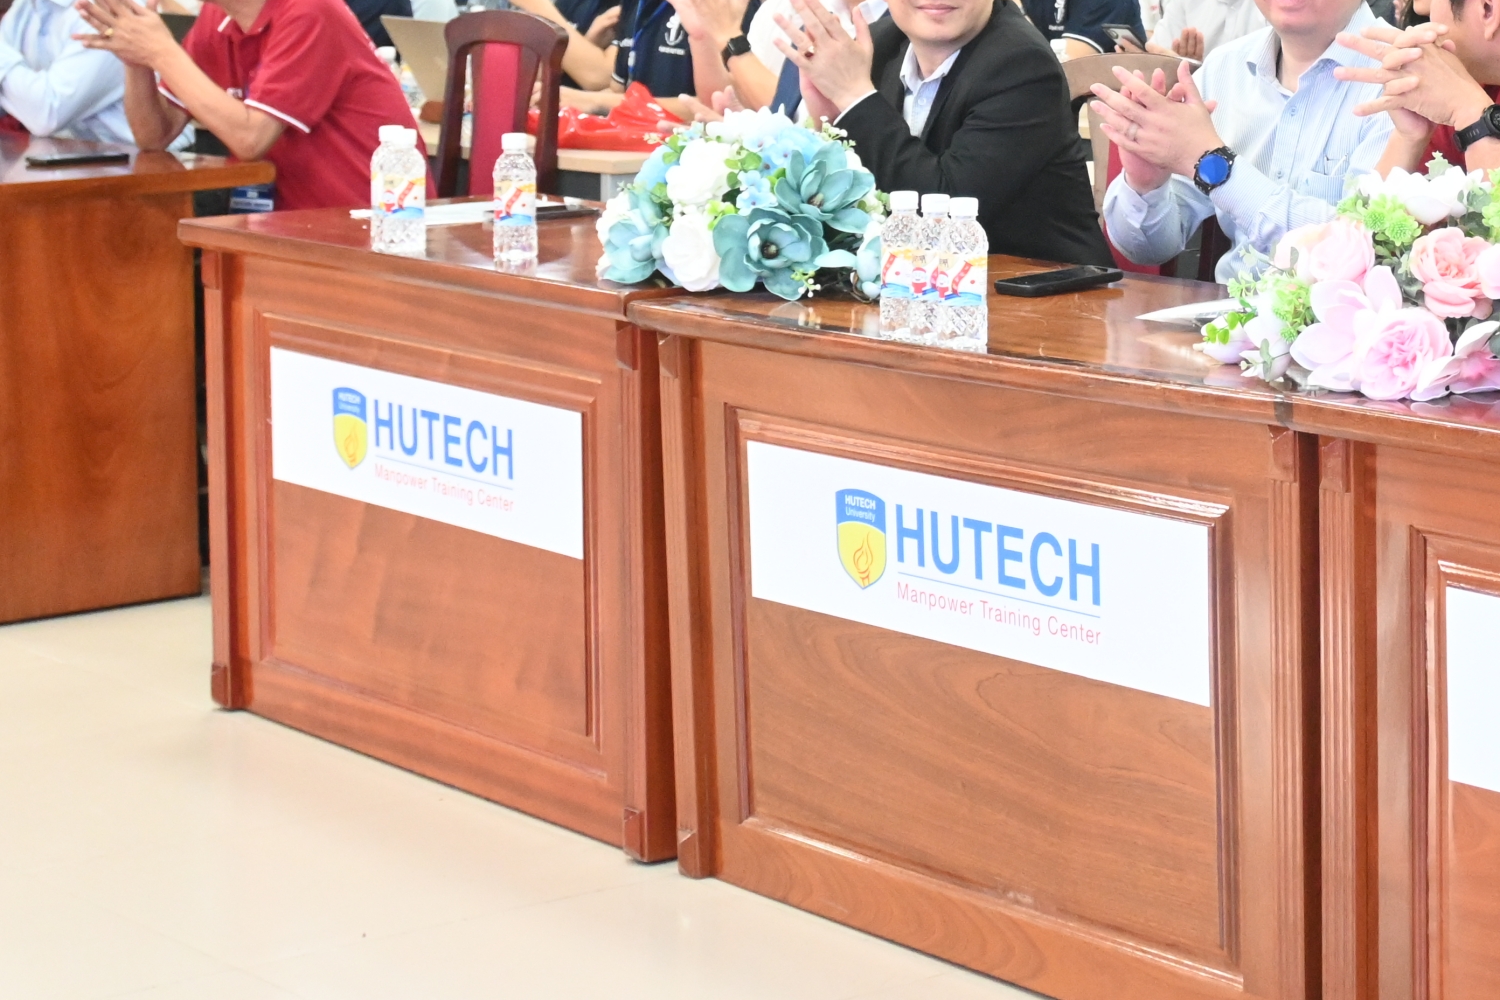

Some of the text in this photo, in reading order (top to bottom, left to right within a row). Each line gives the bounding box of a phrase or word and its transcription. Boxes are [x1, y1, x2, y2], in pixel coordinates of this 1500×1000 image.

[374, 398, 514, 480] HUTECH
[374, 463, 514, 512] Manpower Training Center
[845, 494, 877, 511] HUTECH
[845, 507, 876, 523] University
[895, 503, 1101, 607] HUTECH
[897, 581, 1101, 645] Manpower Training Center
